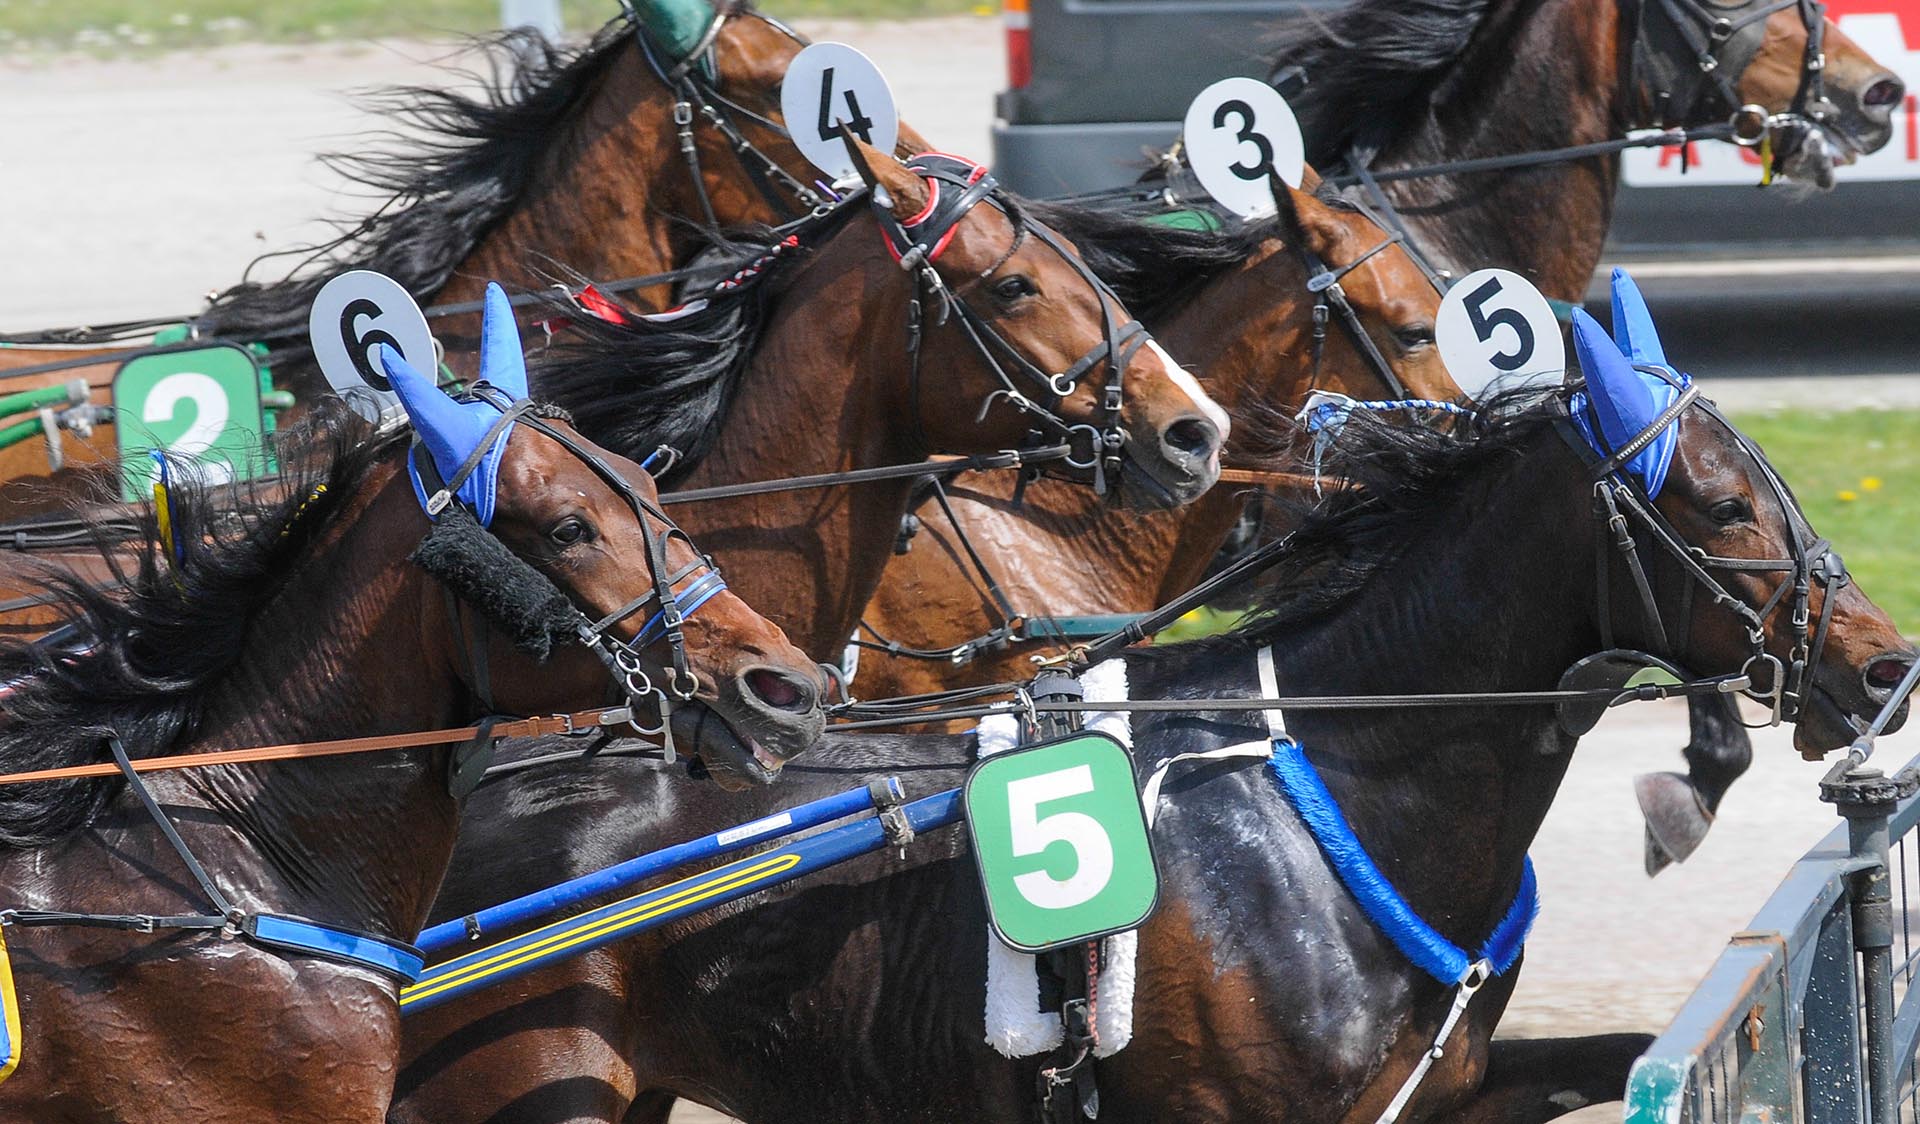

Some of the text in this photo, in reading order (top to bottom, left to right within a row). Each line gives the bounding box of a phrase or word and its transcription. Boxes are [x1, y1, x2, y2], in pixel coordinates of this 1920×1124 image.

[818, 67, 873, 145] 4
[1213, 99, 1273, 180] 3
[340, 298, 407, 392] 6
[1462, 276, 1535, 371] 5
[143, 372, 233, 497] 2
[1007, 763, 1114, 910] 5
